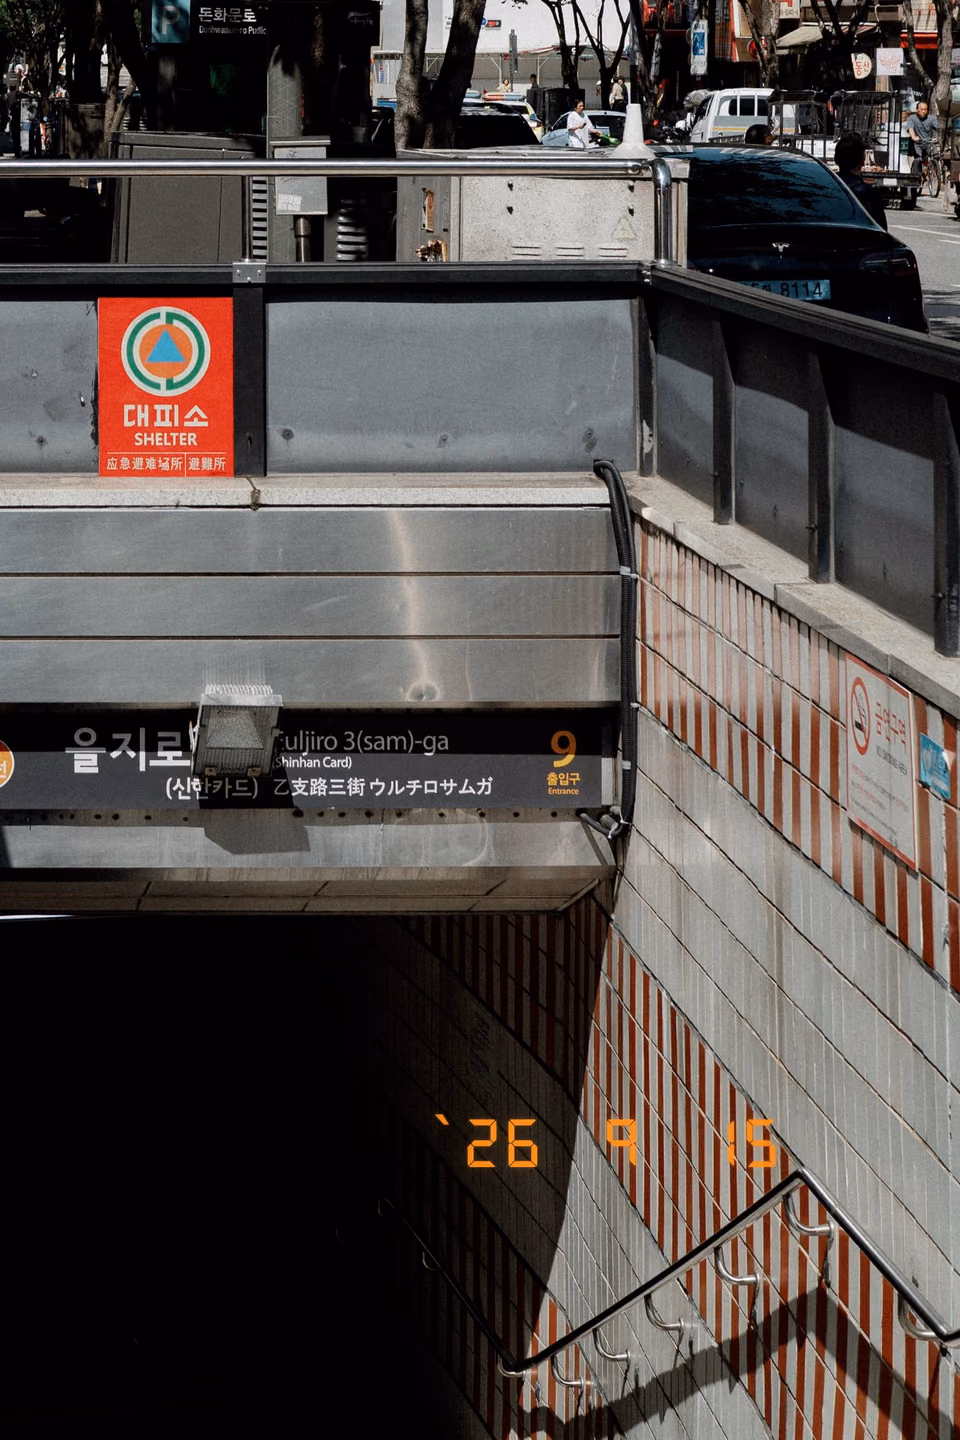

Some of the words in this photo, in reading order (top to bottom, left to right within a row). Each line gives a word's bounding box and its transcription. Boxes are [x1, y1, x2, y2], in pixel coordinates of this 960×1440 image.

[198, 7, 258, 23] 돈화문로
[780, 282, 823, 298] 8114
[123, 404, 209, 427] 대피소
[134, 432, 198, 446] SHELTER
[106, 456, 183, 471] 应急避难场所
[188, 456, 227, 471] 避難所
[874, 700, 907, 754] 금연구역
[280, 729, 339, 757] uljiro
[343, 729, 449, 757] 3(sam)-ga
[551, 731, 577, 768] 9
[273, 756, 320, 769] (Shinhan
[322, 756, 353, 769] Card)
[273, 778, 366, 797] 乙支路三街
[369, 776, 493, 796] ウルチロサムガ
[547, 772, 581, 786] 출입구
[166, 776, 258, 800] (신한카드)
[548, 787, 580, 795] Entrance
